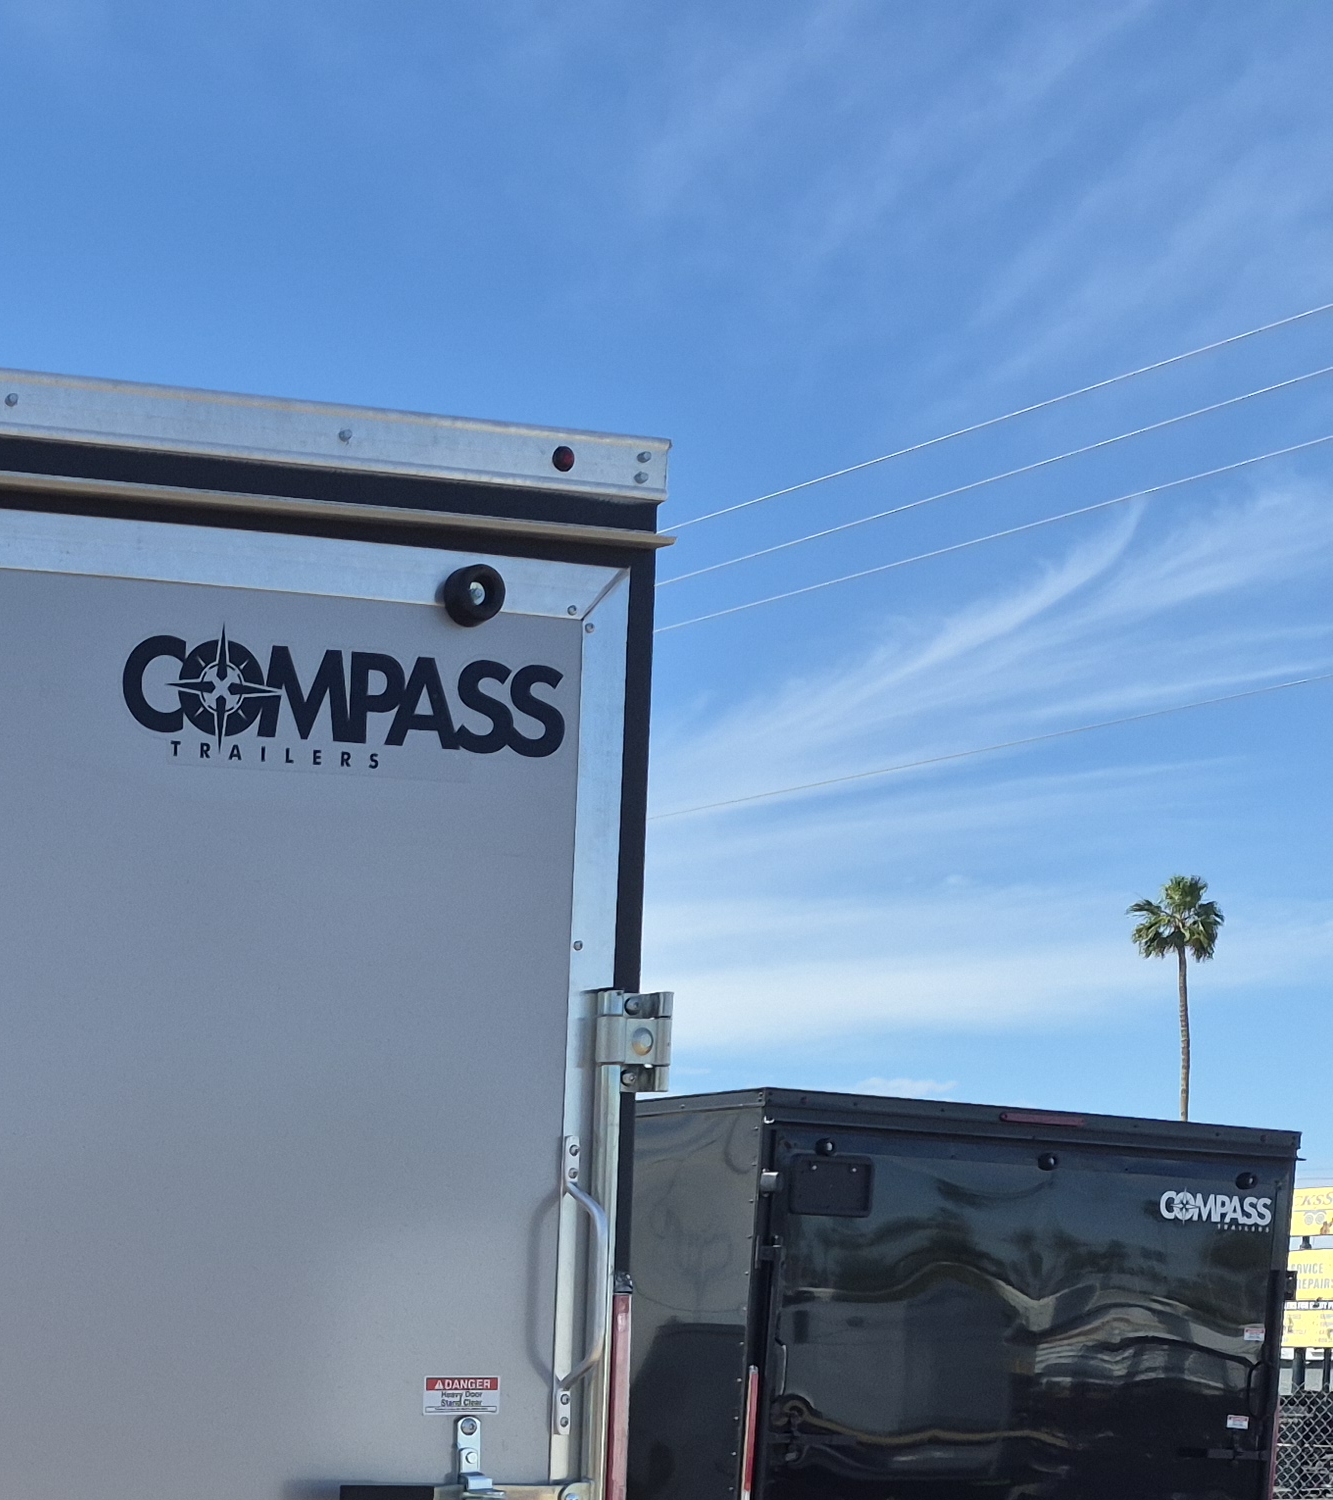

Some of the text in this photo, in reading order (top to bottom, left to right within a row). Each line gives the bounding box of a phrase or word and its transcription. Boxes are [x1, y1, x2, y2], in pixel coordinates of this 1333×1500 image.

[122, 632, 565, 757] COMPASS
[170, 740, 380, 769] TRAILERS
[1160, 1190, 1272, 1226] COMPASS
[444, 1379, 491, 1390] DANGER
